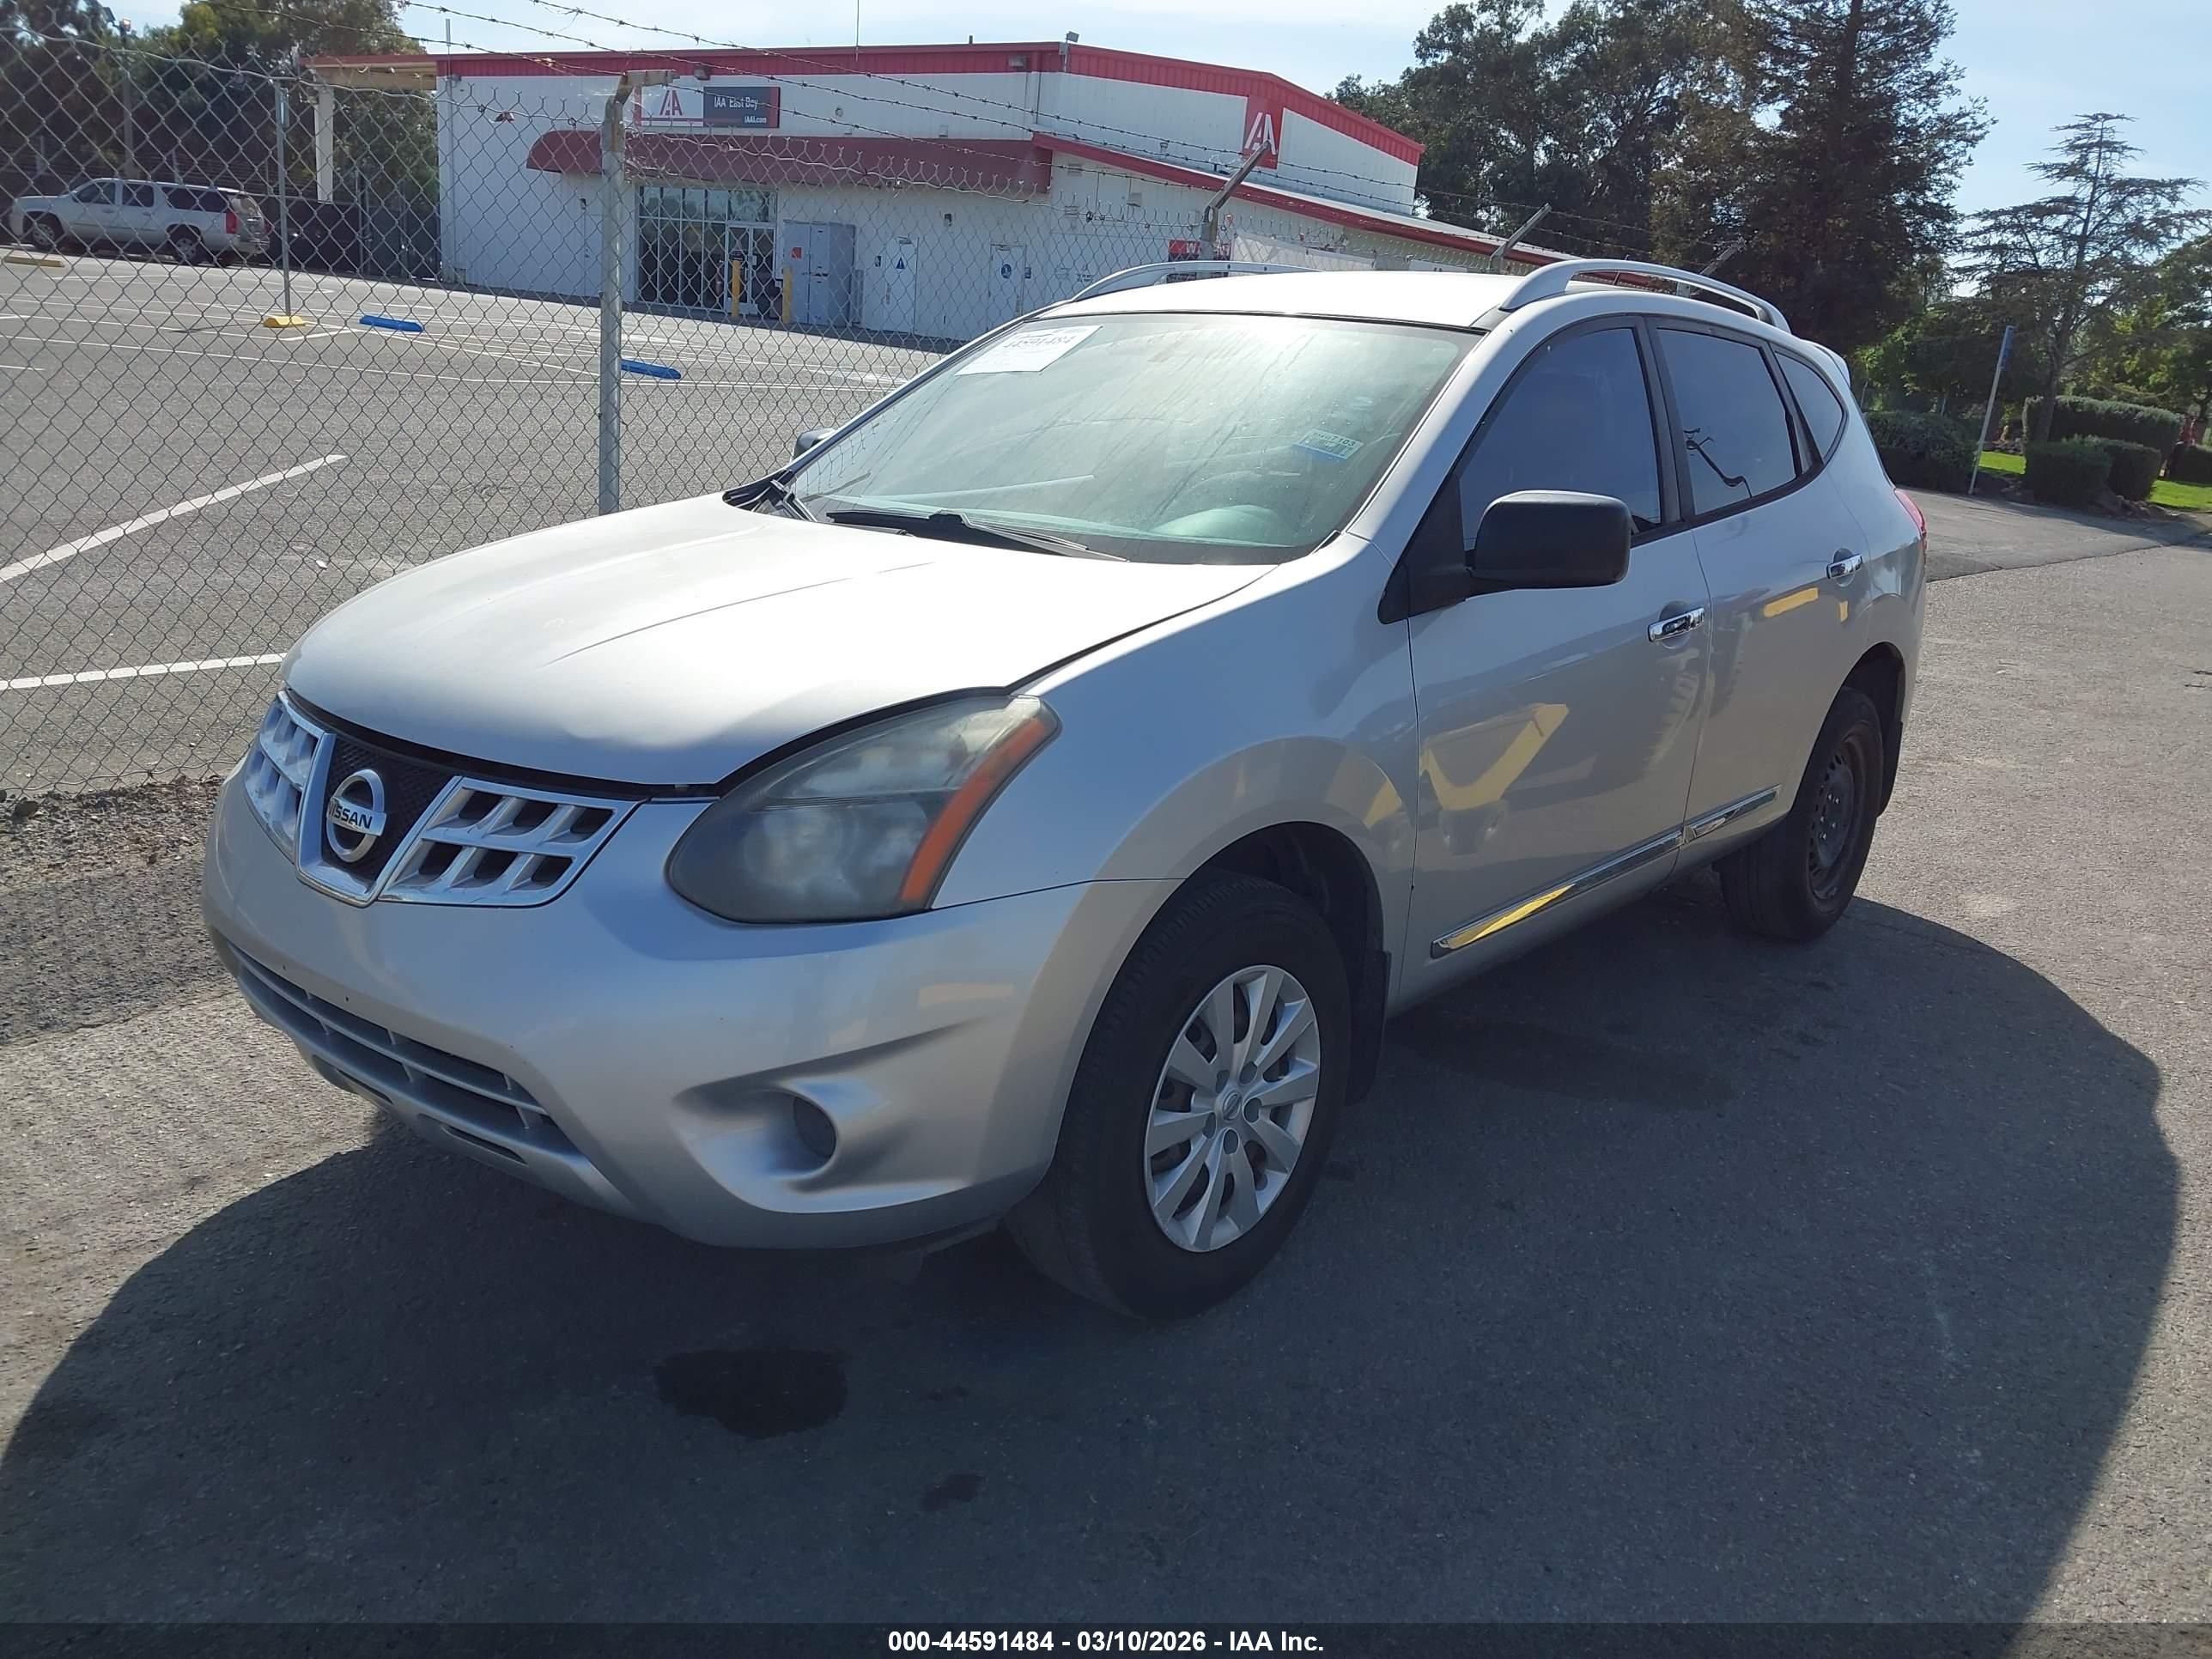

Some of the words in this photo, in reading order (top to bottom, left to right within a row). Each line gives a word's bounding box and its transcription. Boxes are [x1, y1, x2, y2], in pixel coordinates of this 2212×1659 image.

[714, 96, 726, 108] IAA
[729, 97, 744, 108] East
[745, 96, 758, 111] Bay
[328, 802, 373, 830] NISSAN
